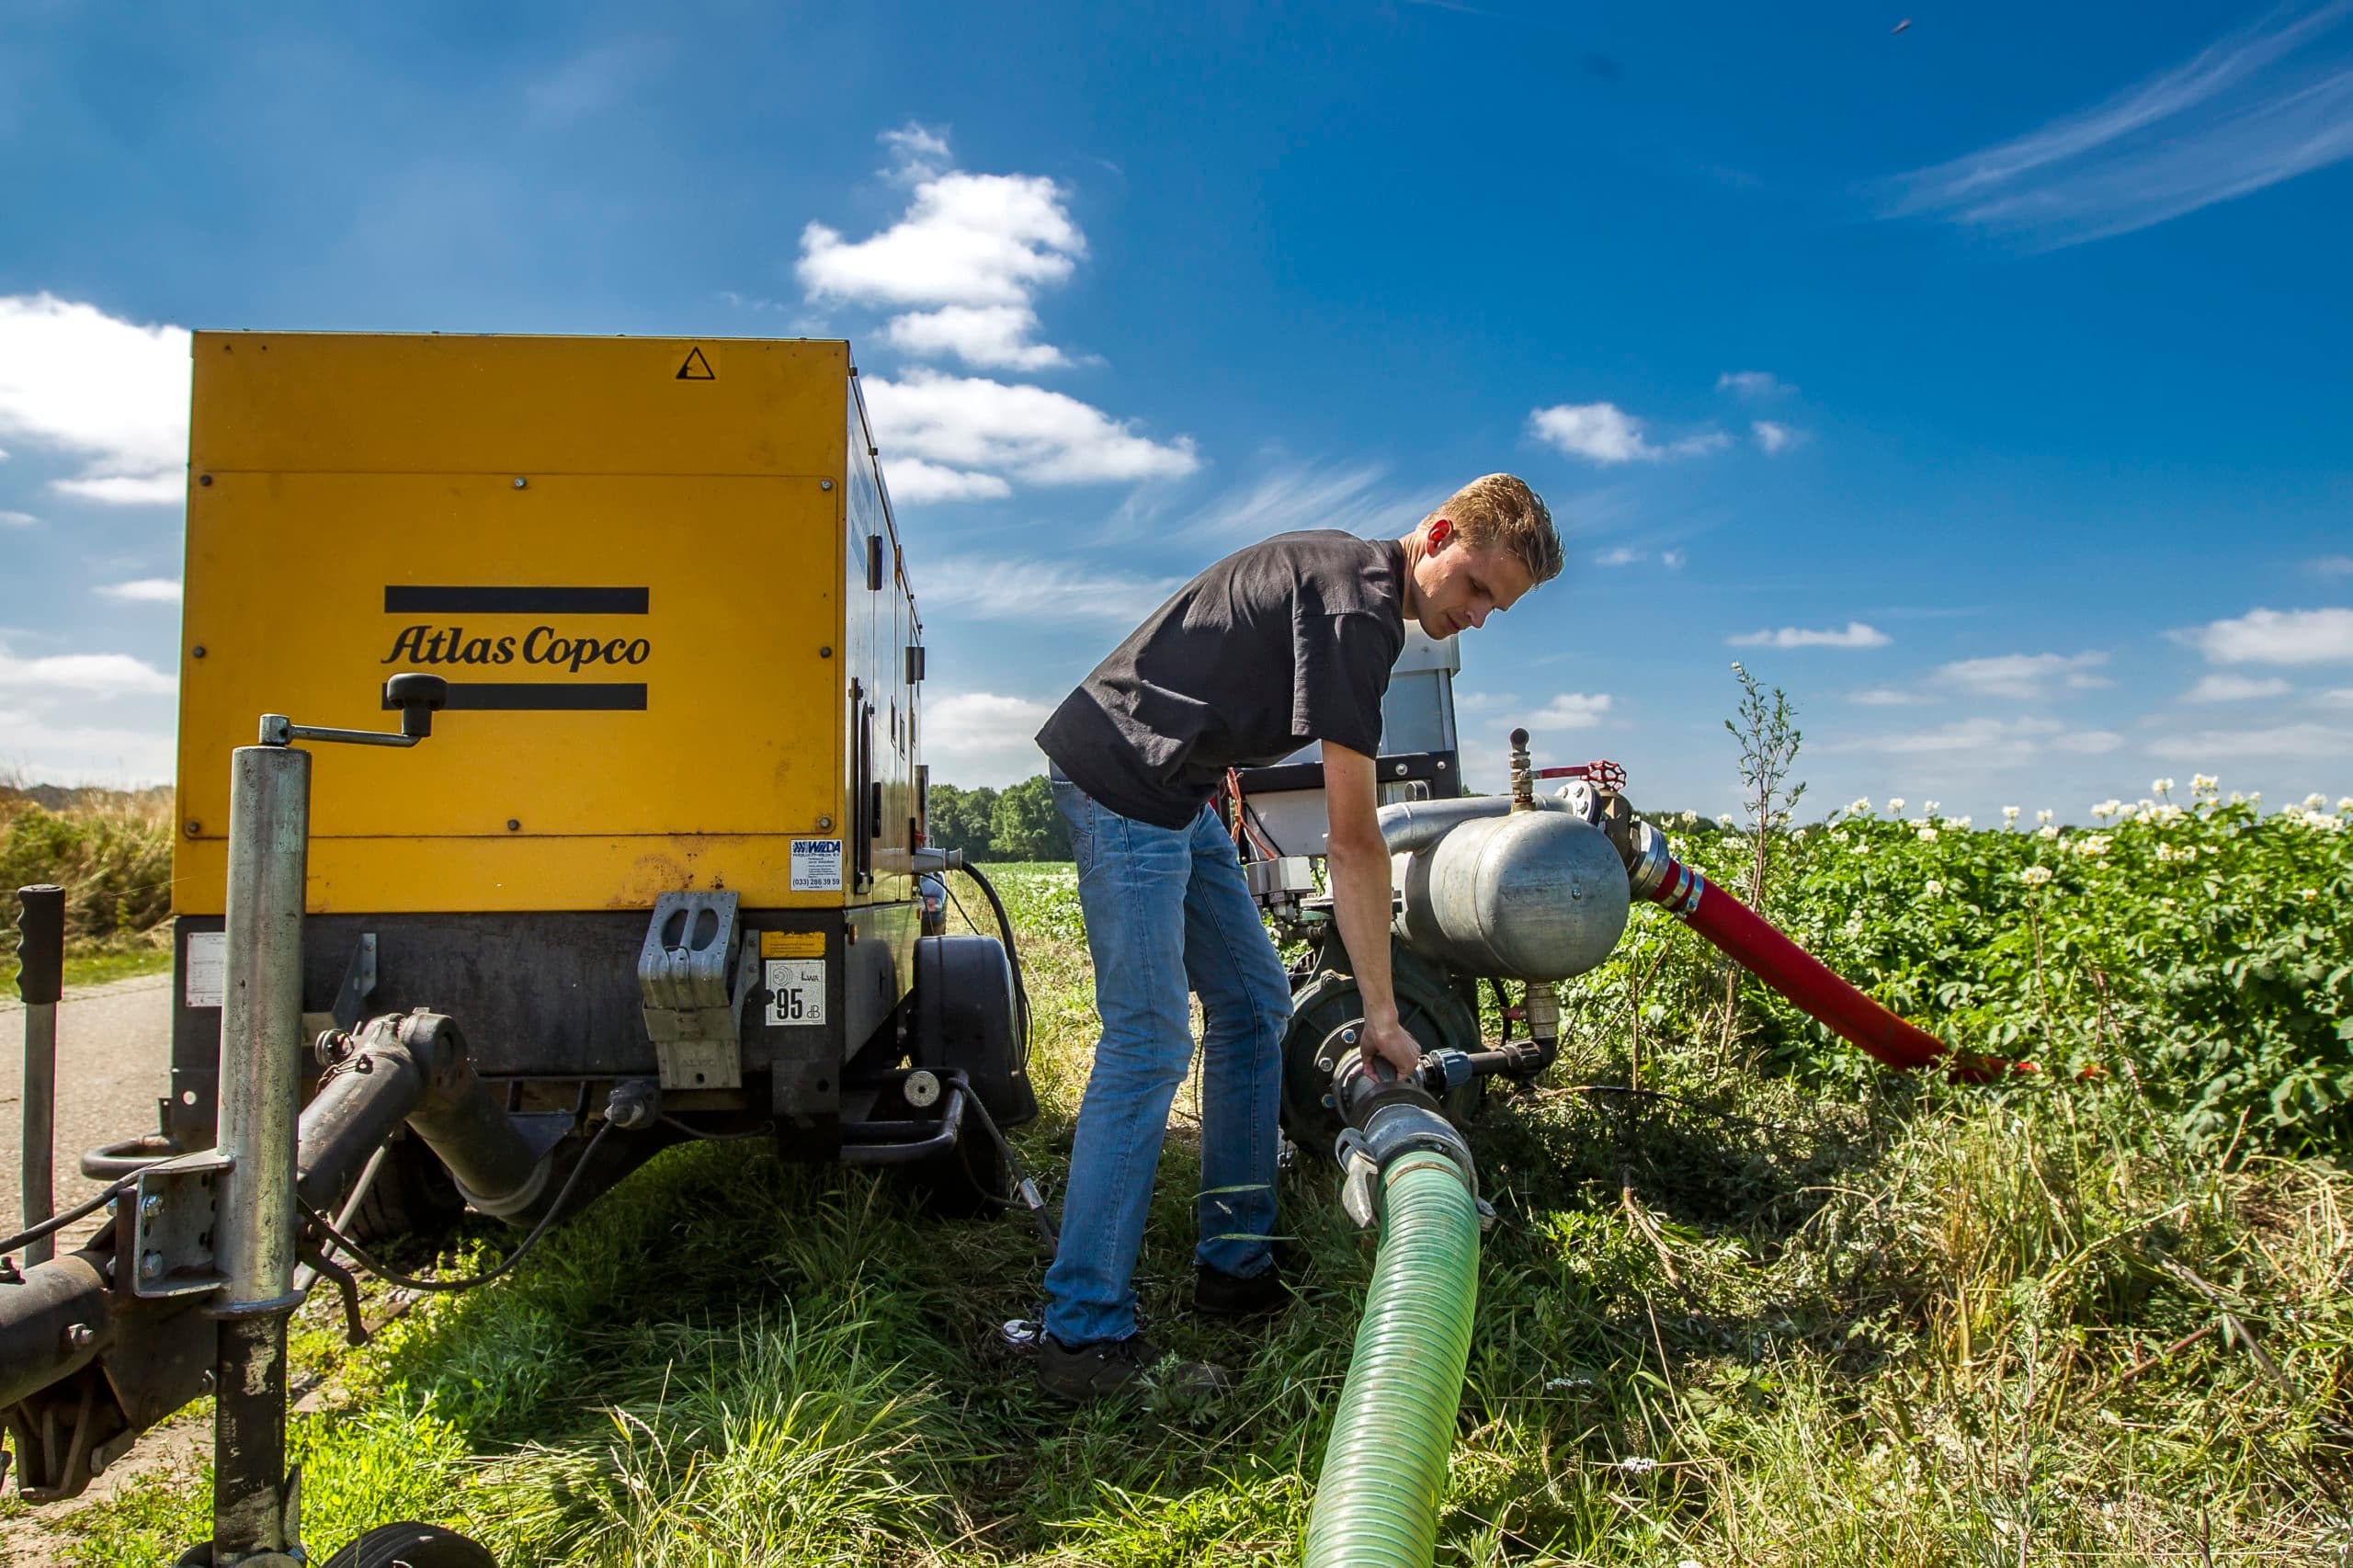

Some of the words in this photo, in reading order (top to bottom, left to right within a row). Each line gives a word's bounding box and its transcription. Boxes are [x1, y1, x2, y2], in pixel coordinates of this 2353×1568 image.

[381, 625, 517, 665] Atlas
[522, 626, 651, 673] Copco
[792, 878, 809, 887] (033)
[776, 988, 803, 1019] 95
[806, 1005, 821, 1019] dB
